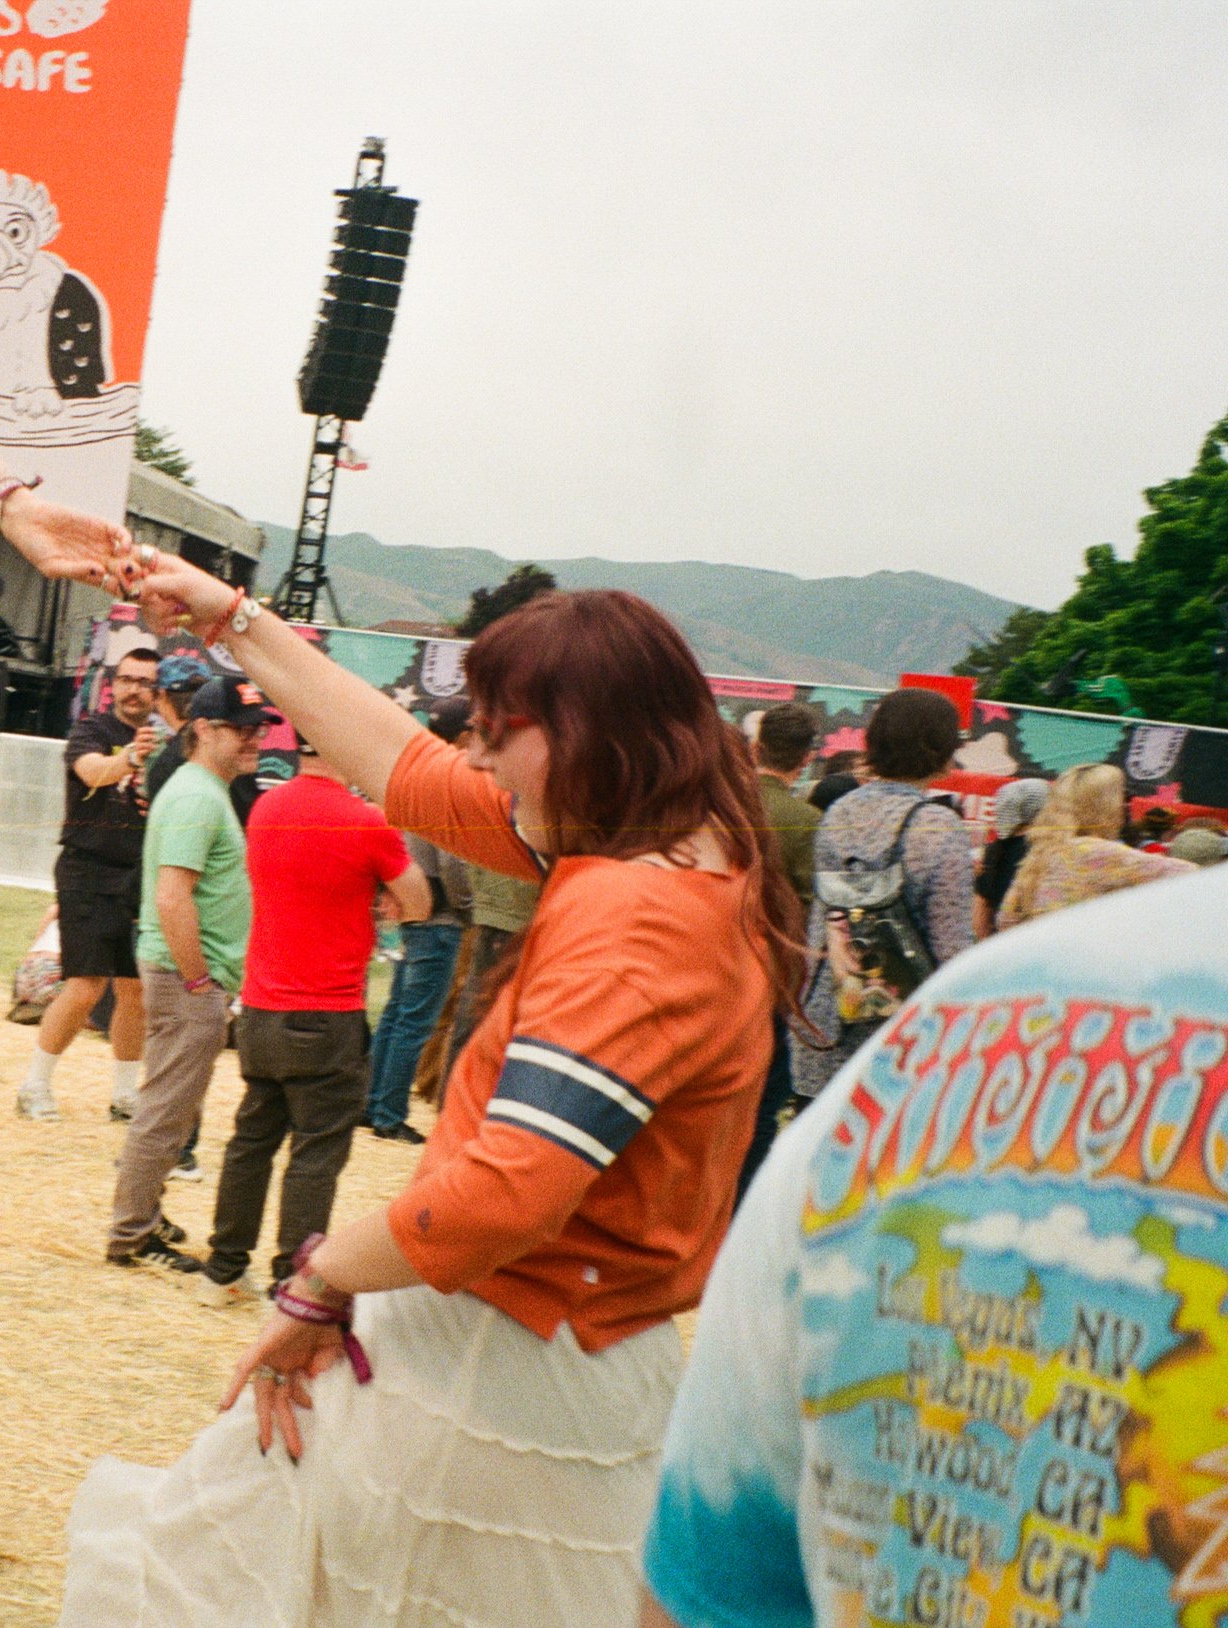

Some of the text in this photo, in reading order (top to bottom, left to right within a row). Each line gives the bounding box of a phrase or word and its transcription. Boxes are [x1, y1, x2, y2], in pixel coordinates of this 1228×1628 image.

[1066, 1303, 1142, 1380] NV
[1052, 1381, 1126, 1458] AZ
[1036, 1457, 1109, 1537] CA
[1021, 1533, 1092, 1614] CA
